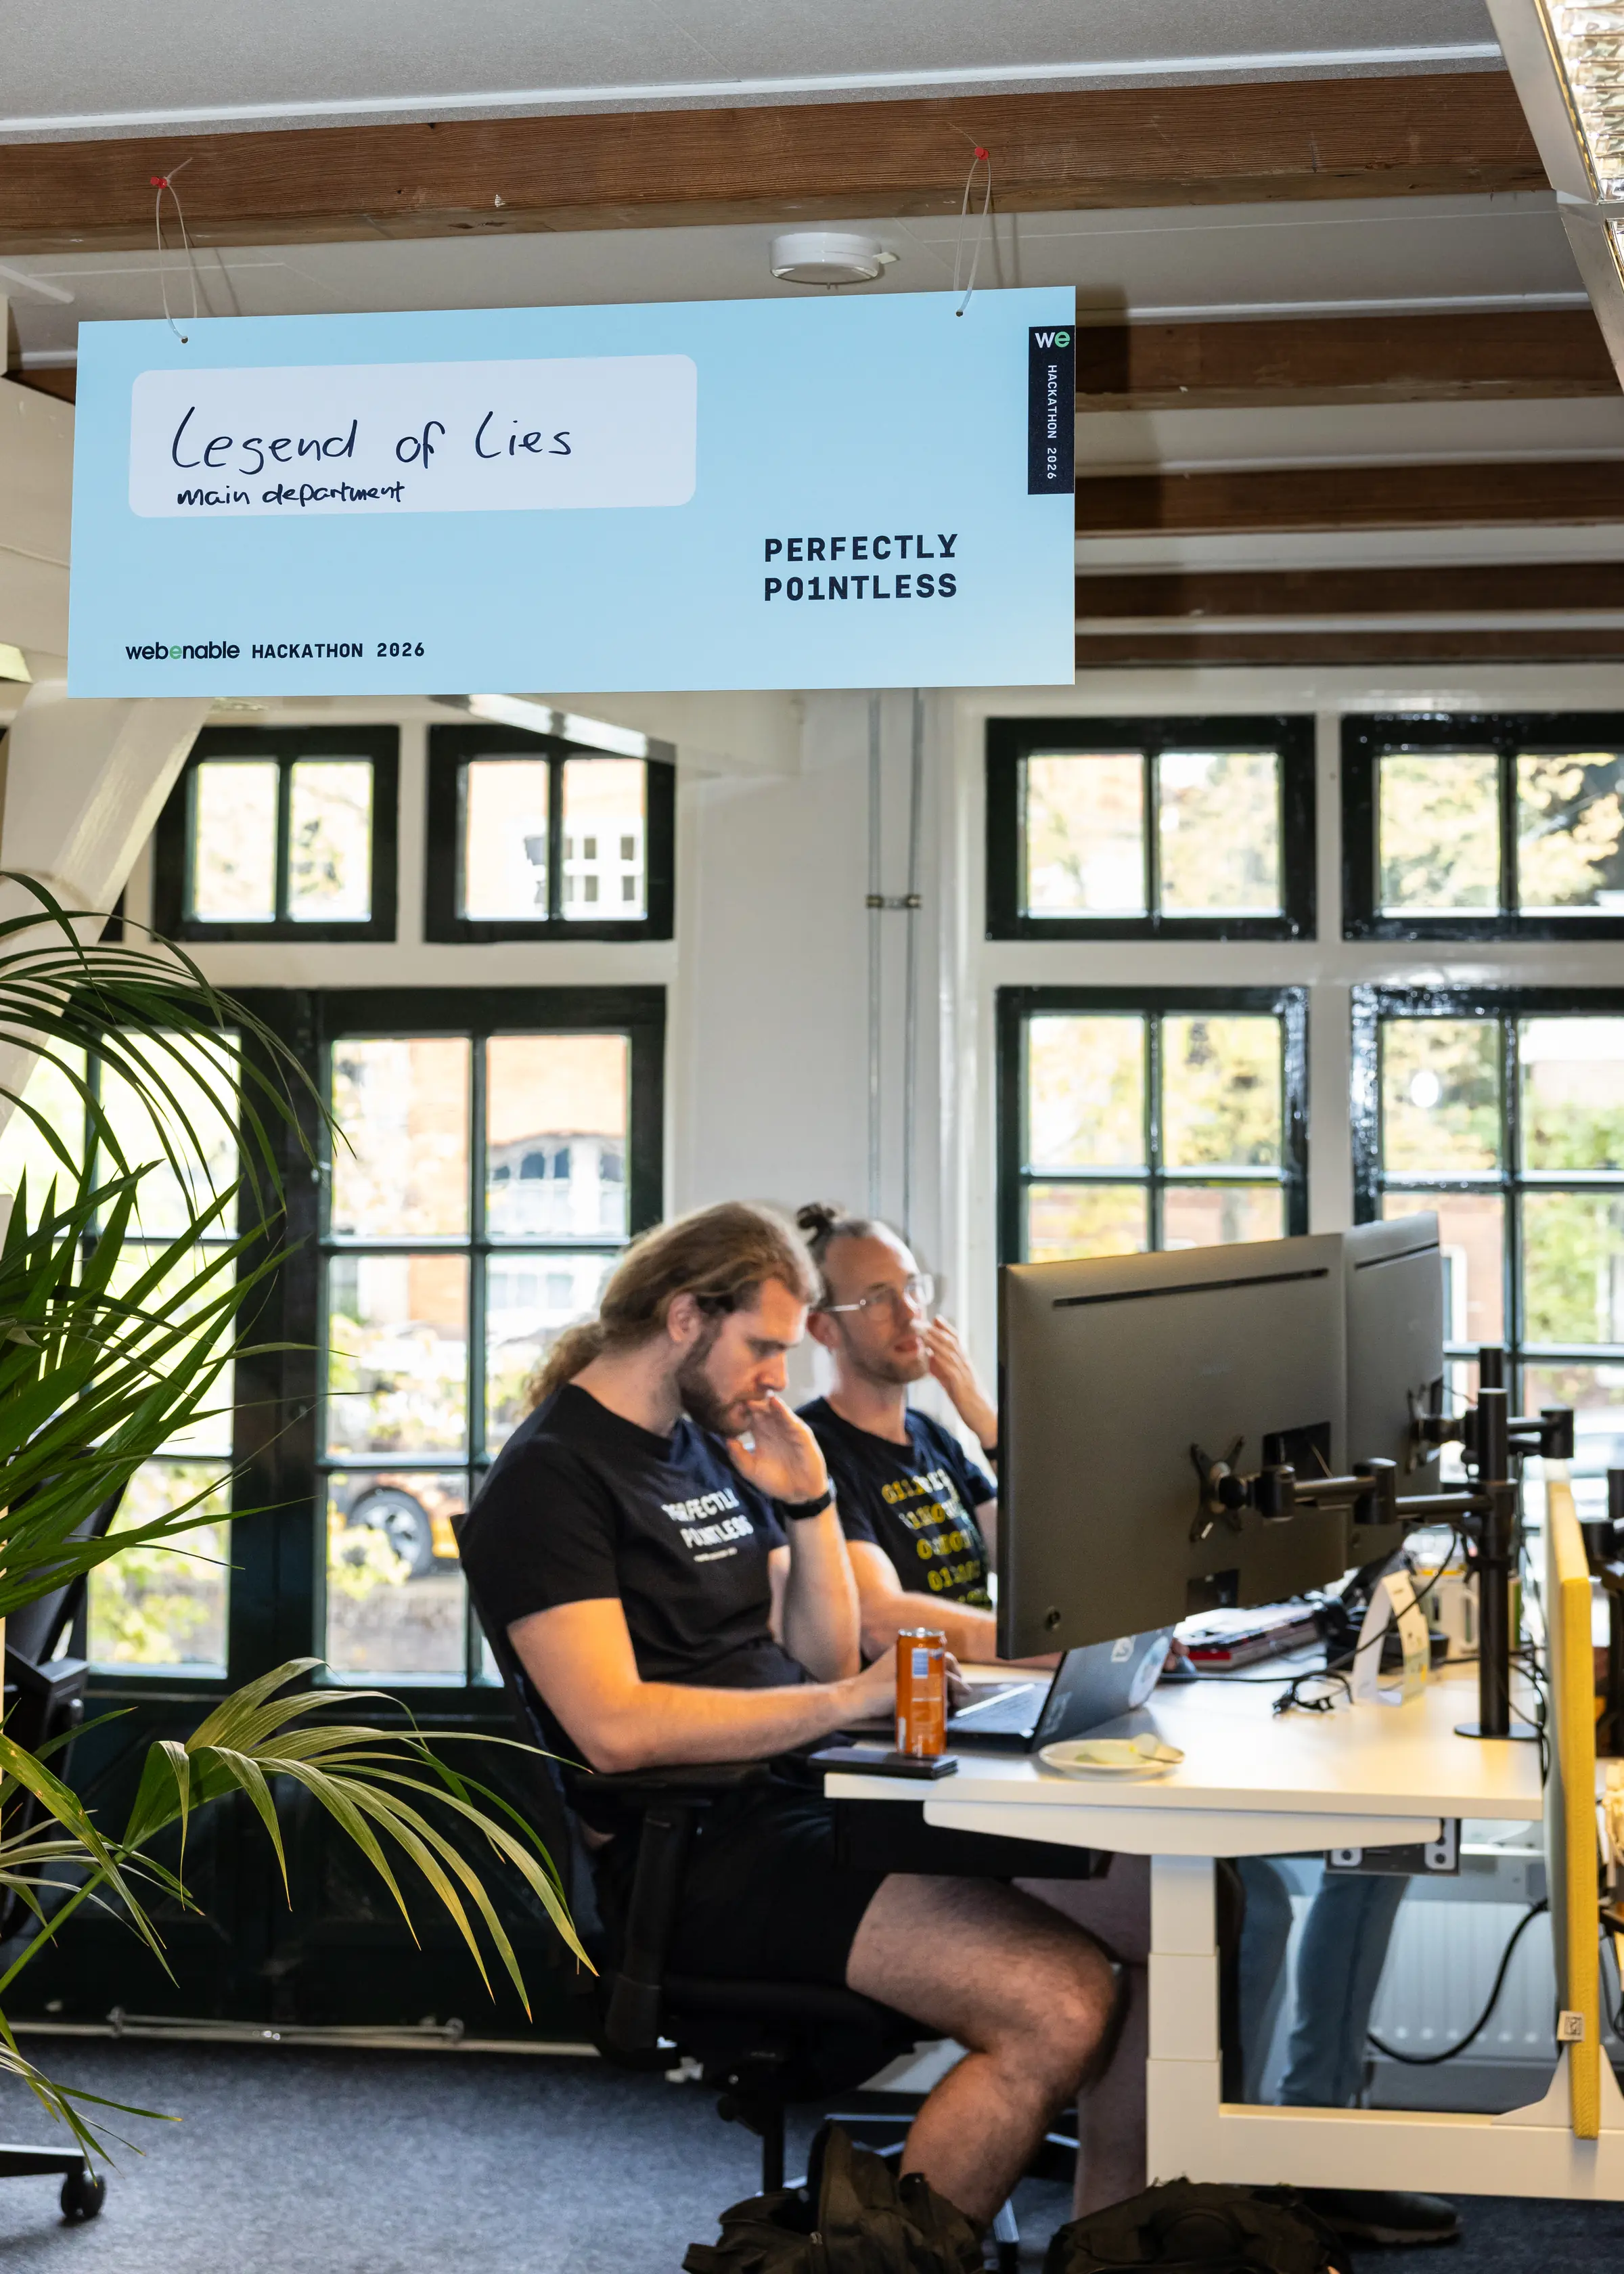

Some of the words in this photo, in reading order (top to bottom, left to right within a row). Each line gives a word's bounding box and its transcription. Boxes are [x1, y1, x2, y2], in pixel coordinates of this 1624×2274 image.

[1035, 331, 1070, 349] we
[1047, 365, 1058, 439] HACKATHON
[172, 406, 358, 475] Legend
[395, 420, 446, 469] of
[1047, 447, 1057, 479] 2026
[177, 485, 250, 506] main
[262, 481, 405, 508] department
[765, 533, 958, 562] PERFECTLY
[125, 640, 241, 661] webenable
[252, 643, 363, 659] HACKATHON
[377, 642, 425, 657] 2026
[660, 1488, 740, 1522] FECTL
[679, 1515, 754, 1548] PTLESS
